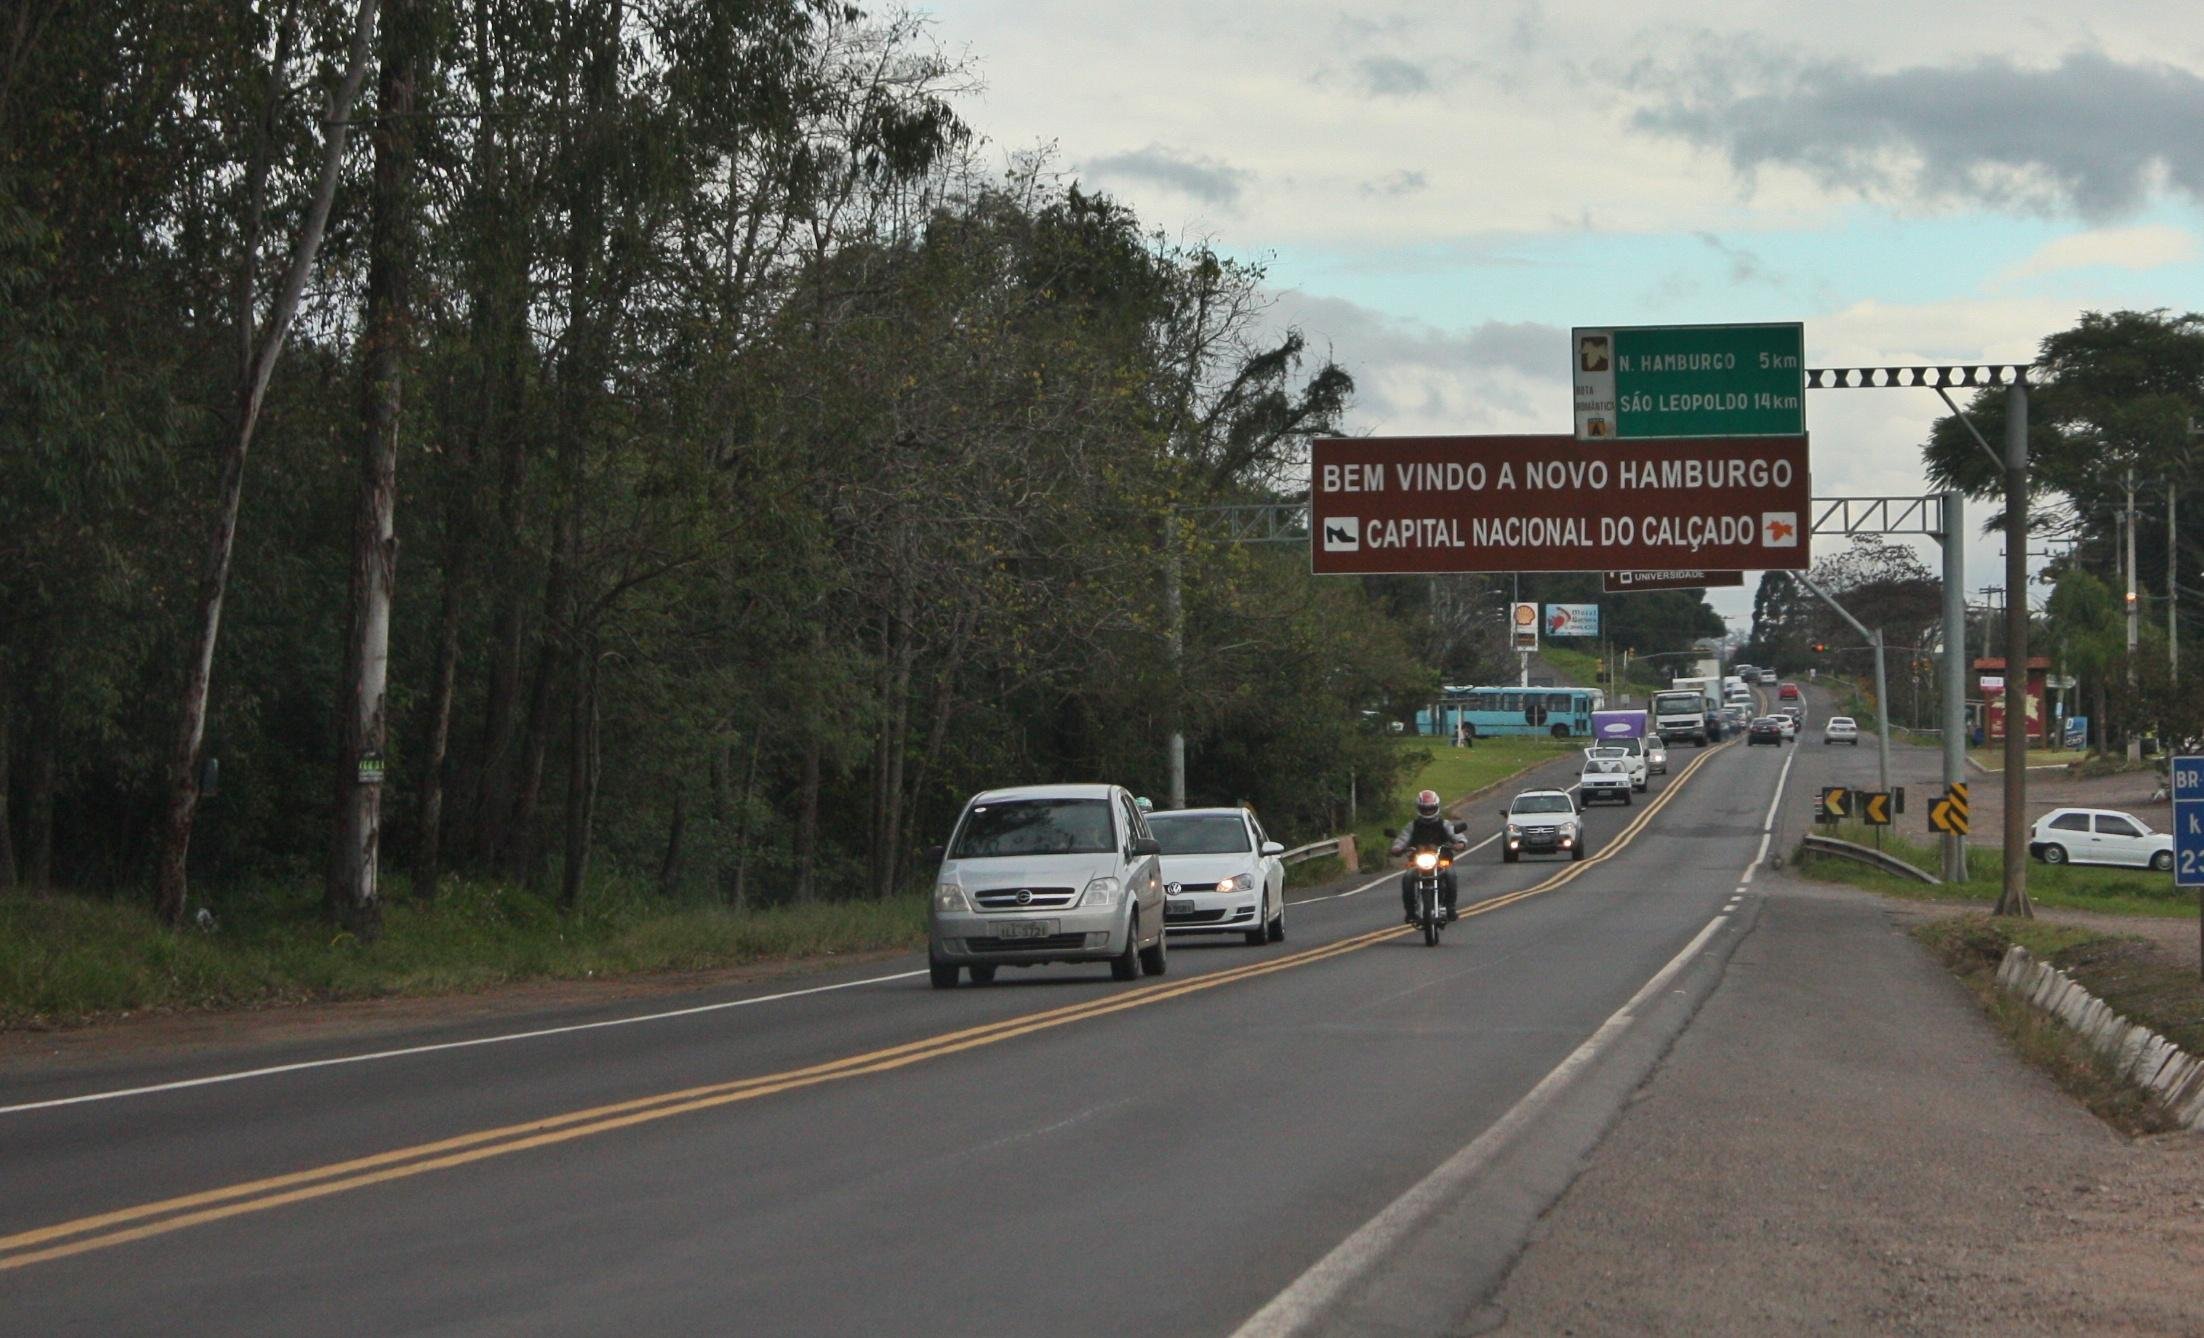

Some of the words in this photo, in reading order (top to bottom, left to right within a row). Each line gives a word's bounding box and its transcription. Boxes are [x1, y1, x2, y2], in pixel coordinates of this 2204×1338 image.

[1619, 355, 1635, 372] N.
[1641, 353, 1736, 371] HAMBURGO
[1659, 394, 1748, 411] LEOPOLDO
[1323, 464, 1384, 492] BEM
[1396, 462, 1486, 491] VINDO
[1496, 461, 1516, 490] A
[1526, 460, 1608, 489] NOVO
[1619, 459, 1792, 489] HAMBURGO
[1366, 518, 1465, 548] CAPITAL
[1472, 517, 1593, 547] NACIONAL
[1600, 516, 1634, 546] DO
[1642, 515, 1755, 552] CALÇADO
